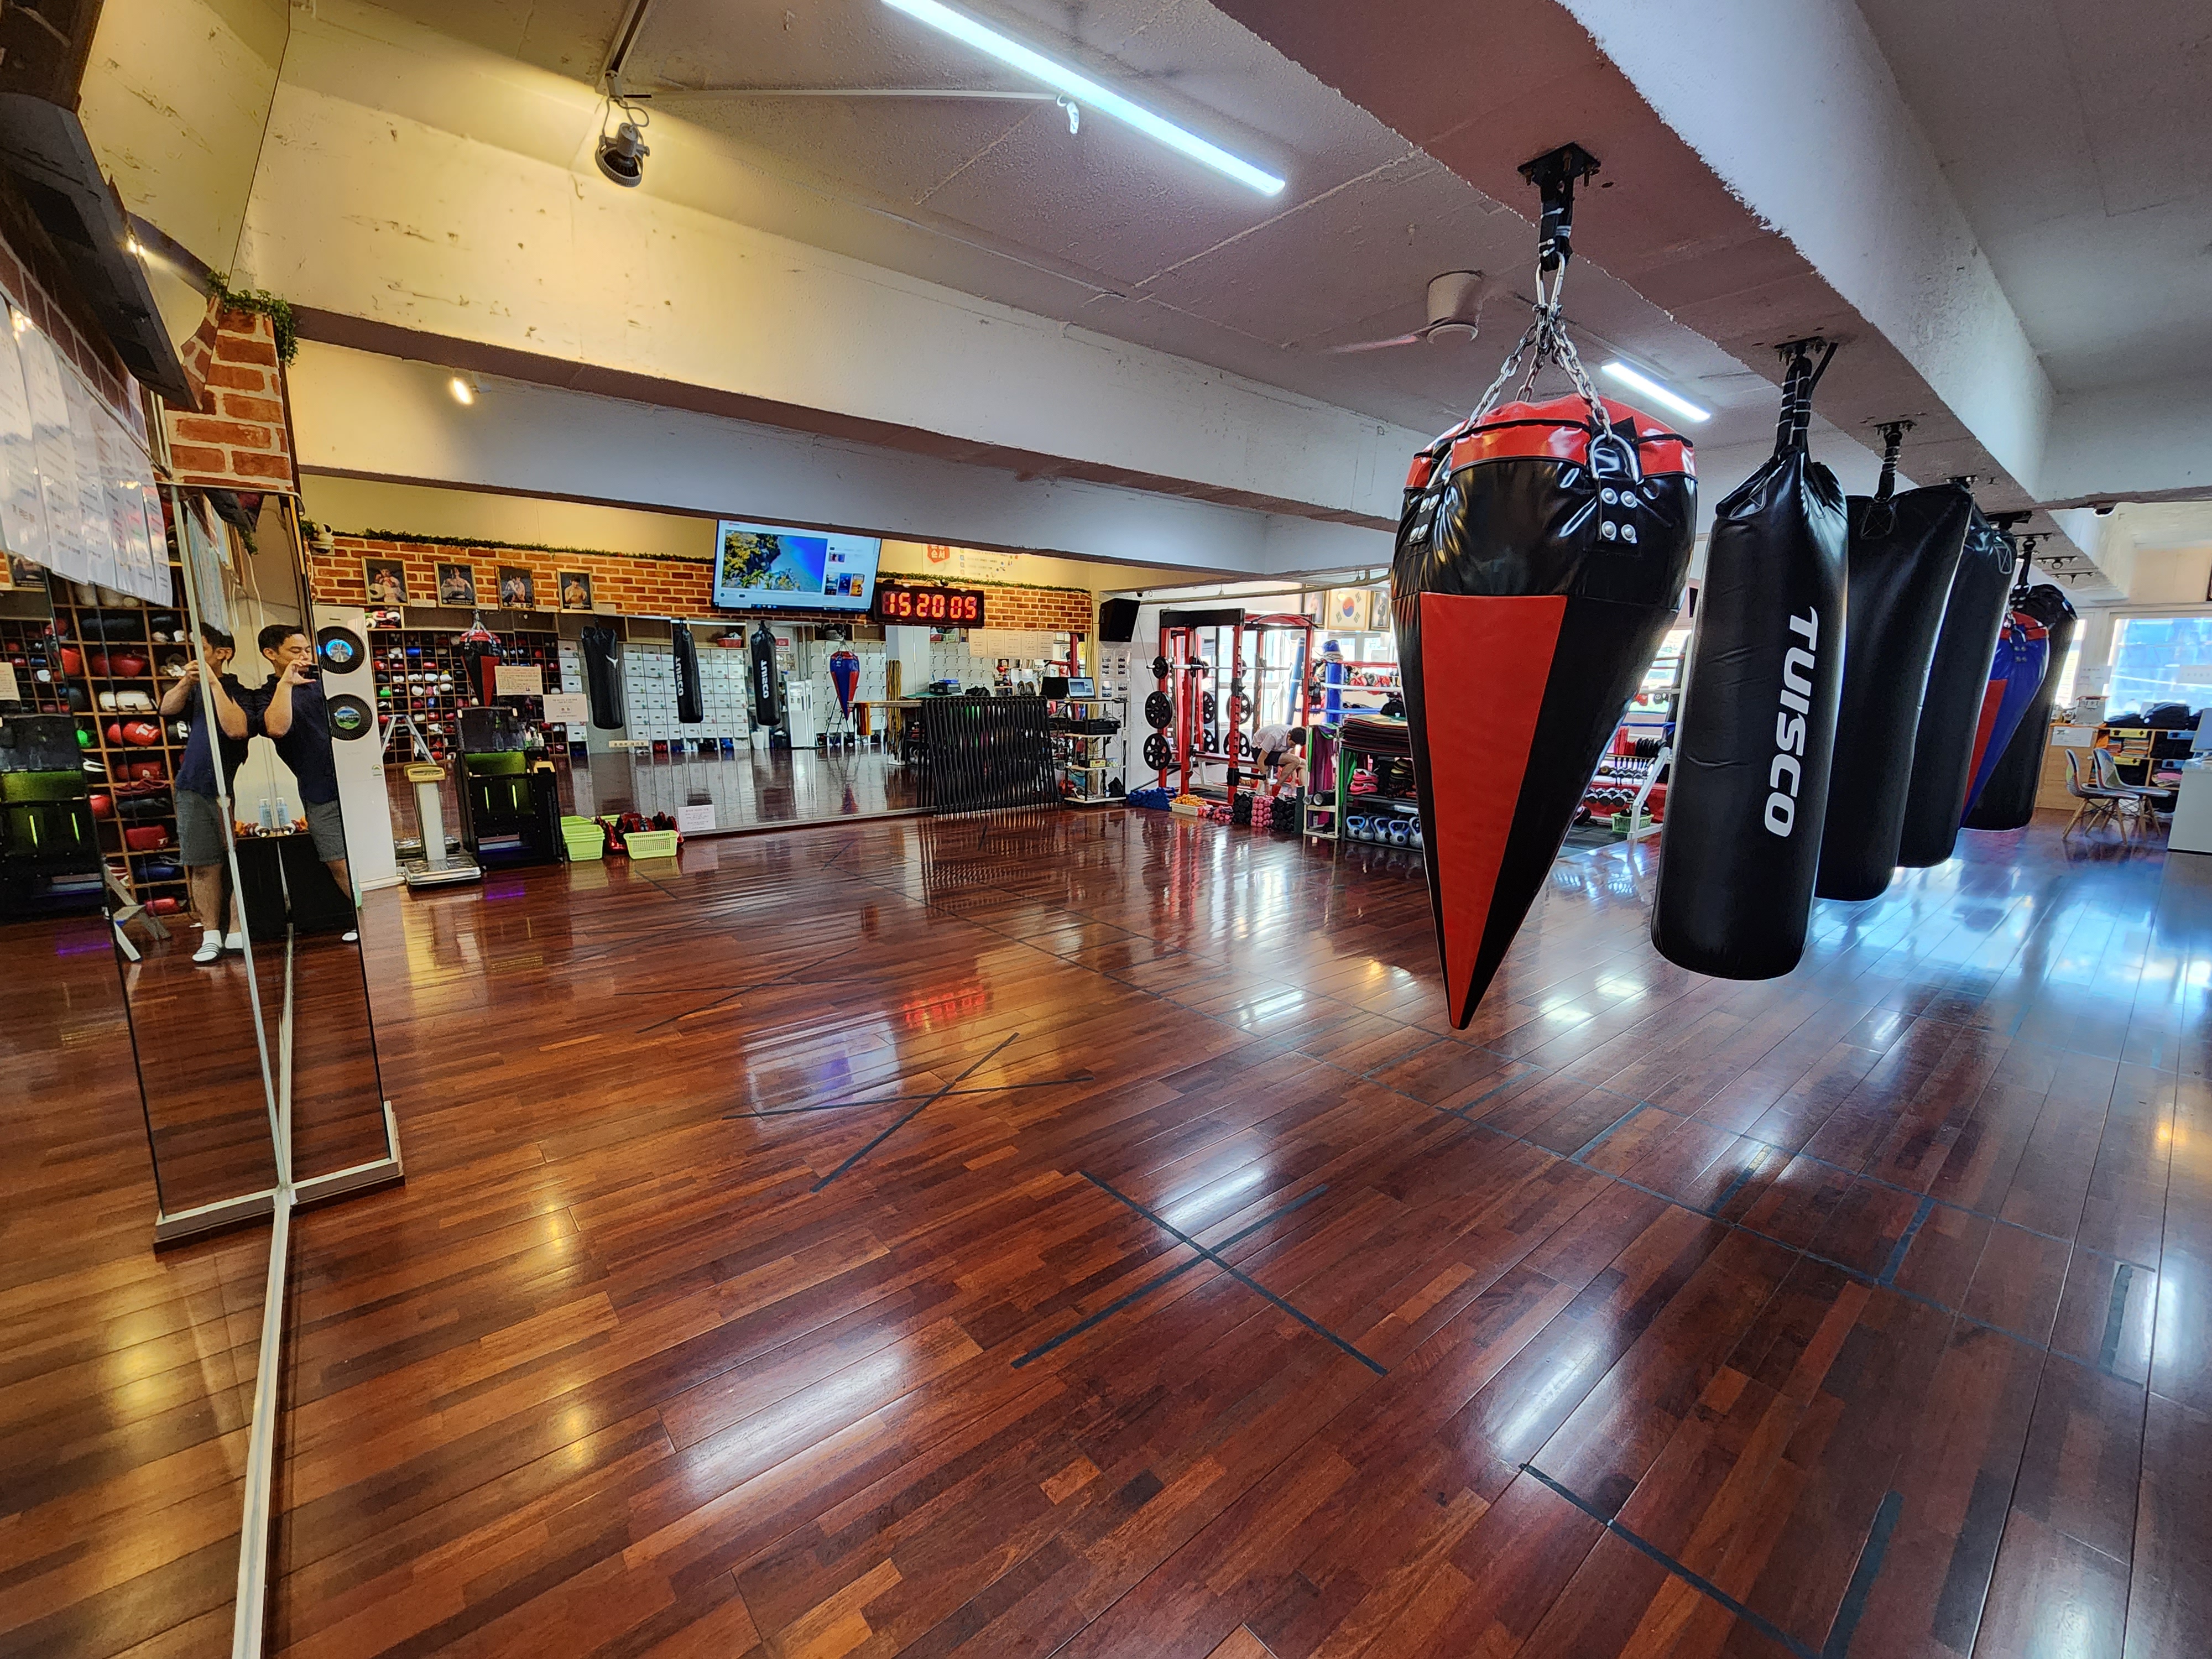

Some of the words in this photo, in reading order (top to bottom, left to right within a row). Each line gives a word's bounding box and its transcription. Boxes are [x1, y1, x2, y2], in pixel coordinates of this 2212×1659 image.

[931, 550, 945, 559] 순서
[889, 592, 912, 617] 15
[916, 593, 946, 618] 20
[950, 596, 977, 619] 05
[1764, 606, 1818, 837] TUISCO
